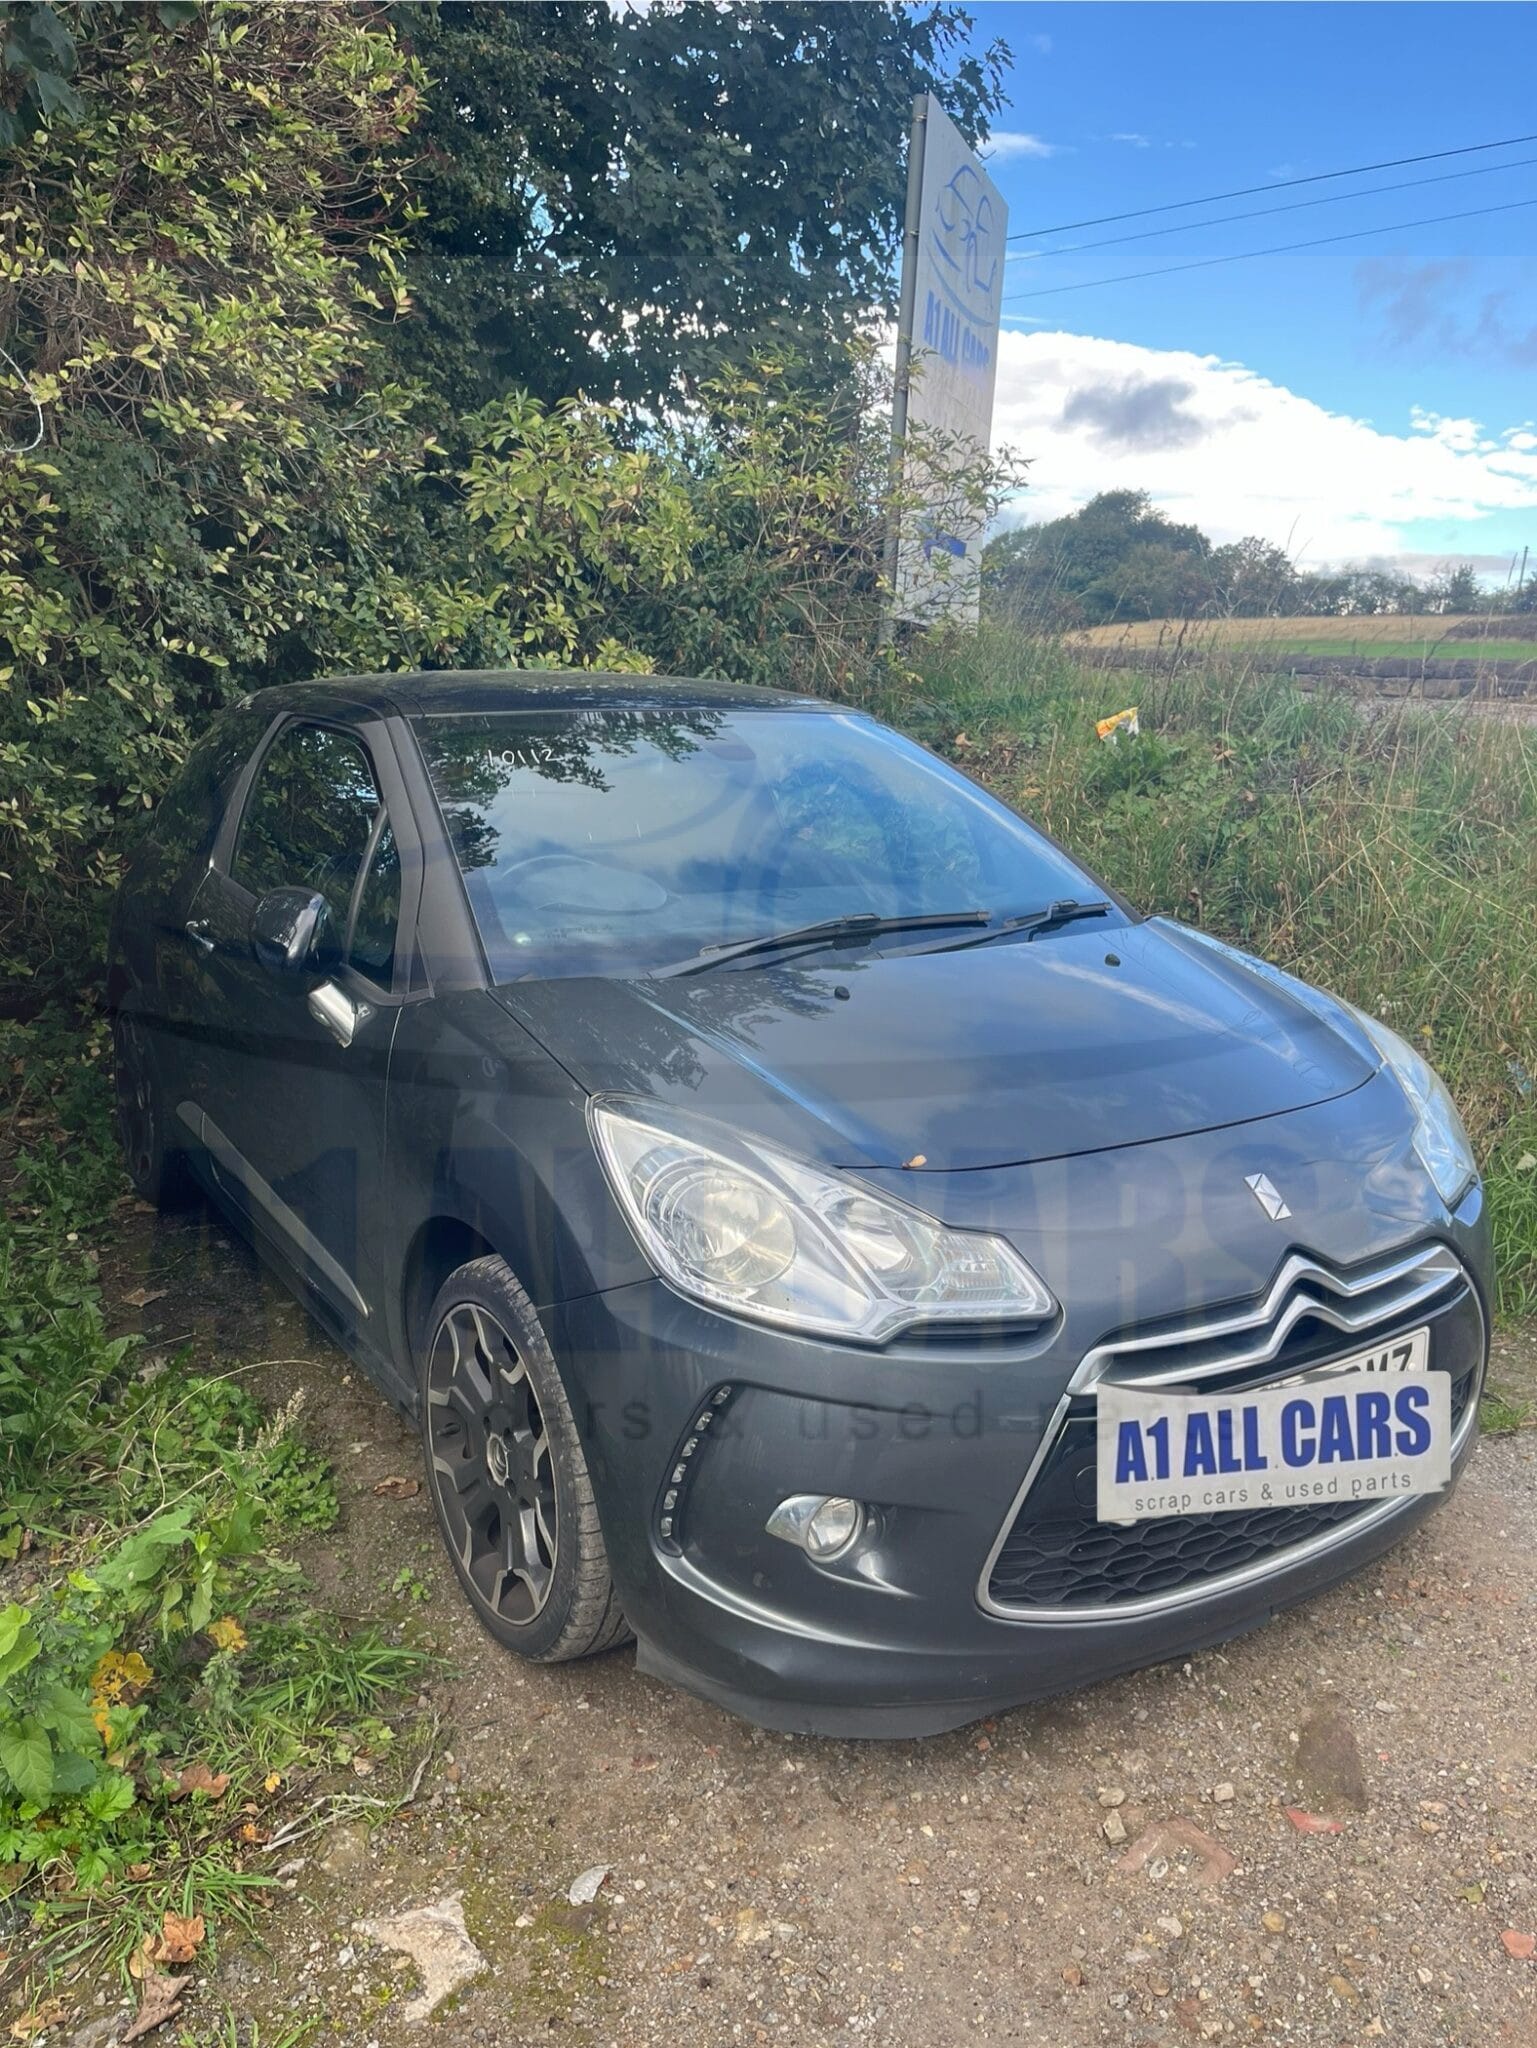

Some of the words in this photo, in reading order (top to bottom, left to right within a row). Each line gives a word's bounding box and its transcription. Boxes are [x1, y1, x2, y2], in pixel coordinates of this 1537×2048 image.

[923, 289, 941, 350] A1
[486, 748, 561, 766] 10112
[1115, 1416, 1170, 1484] A1
[1183, 1406, 1268, 1477] ALL
[1280, 1385, 1432, 1468] CARS
[1135, 1492, 1192, 1512] scrap
[1203, 1486, 1249, 1506] cars
[1260, 1482, 1273, 1501] &
[1286, 1477, 1338, 1499] used
[1351, 1471, 1412, 1496] parts
